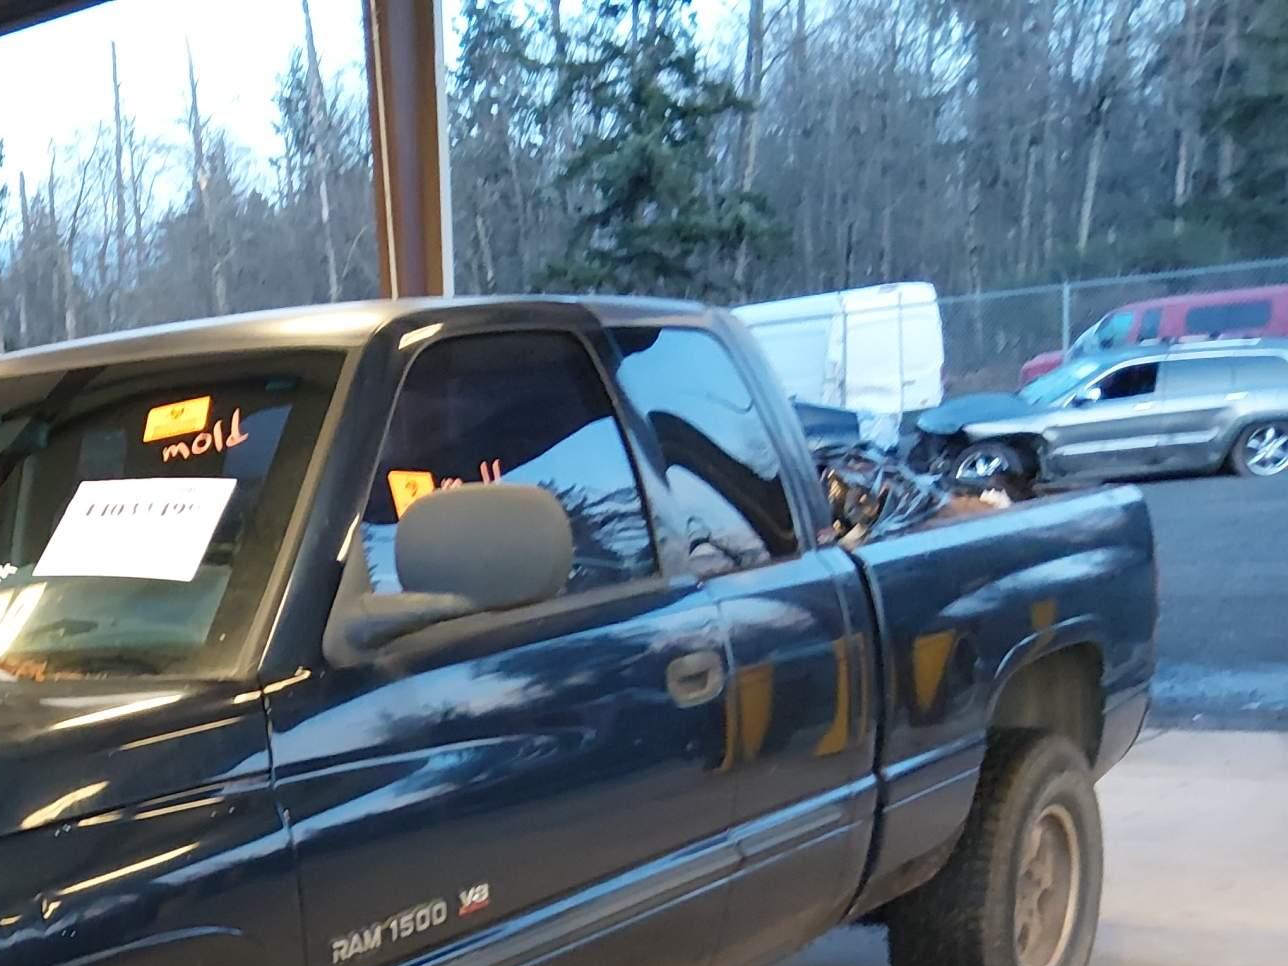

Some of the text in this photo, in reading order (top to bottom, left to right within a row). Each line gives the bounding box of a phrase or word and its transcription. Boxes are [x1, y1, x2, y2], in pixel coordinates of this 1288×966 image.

[162, 407, 249, 463] mold
[331, 883, 489, 964] RAM 1500 V8
